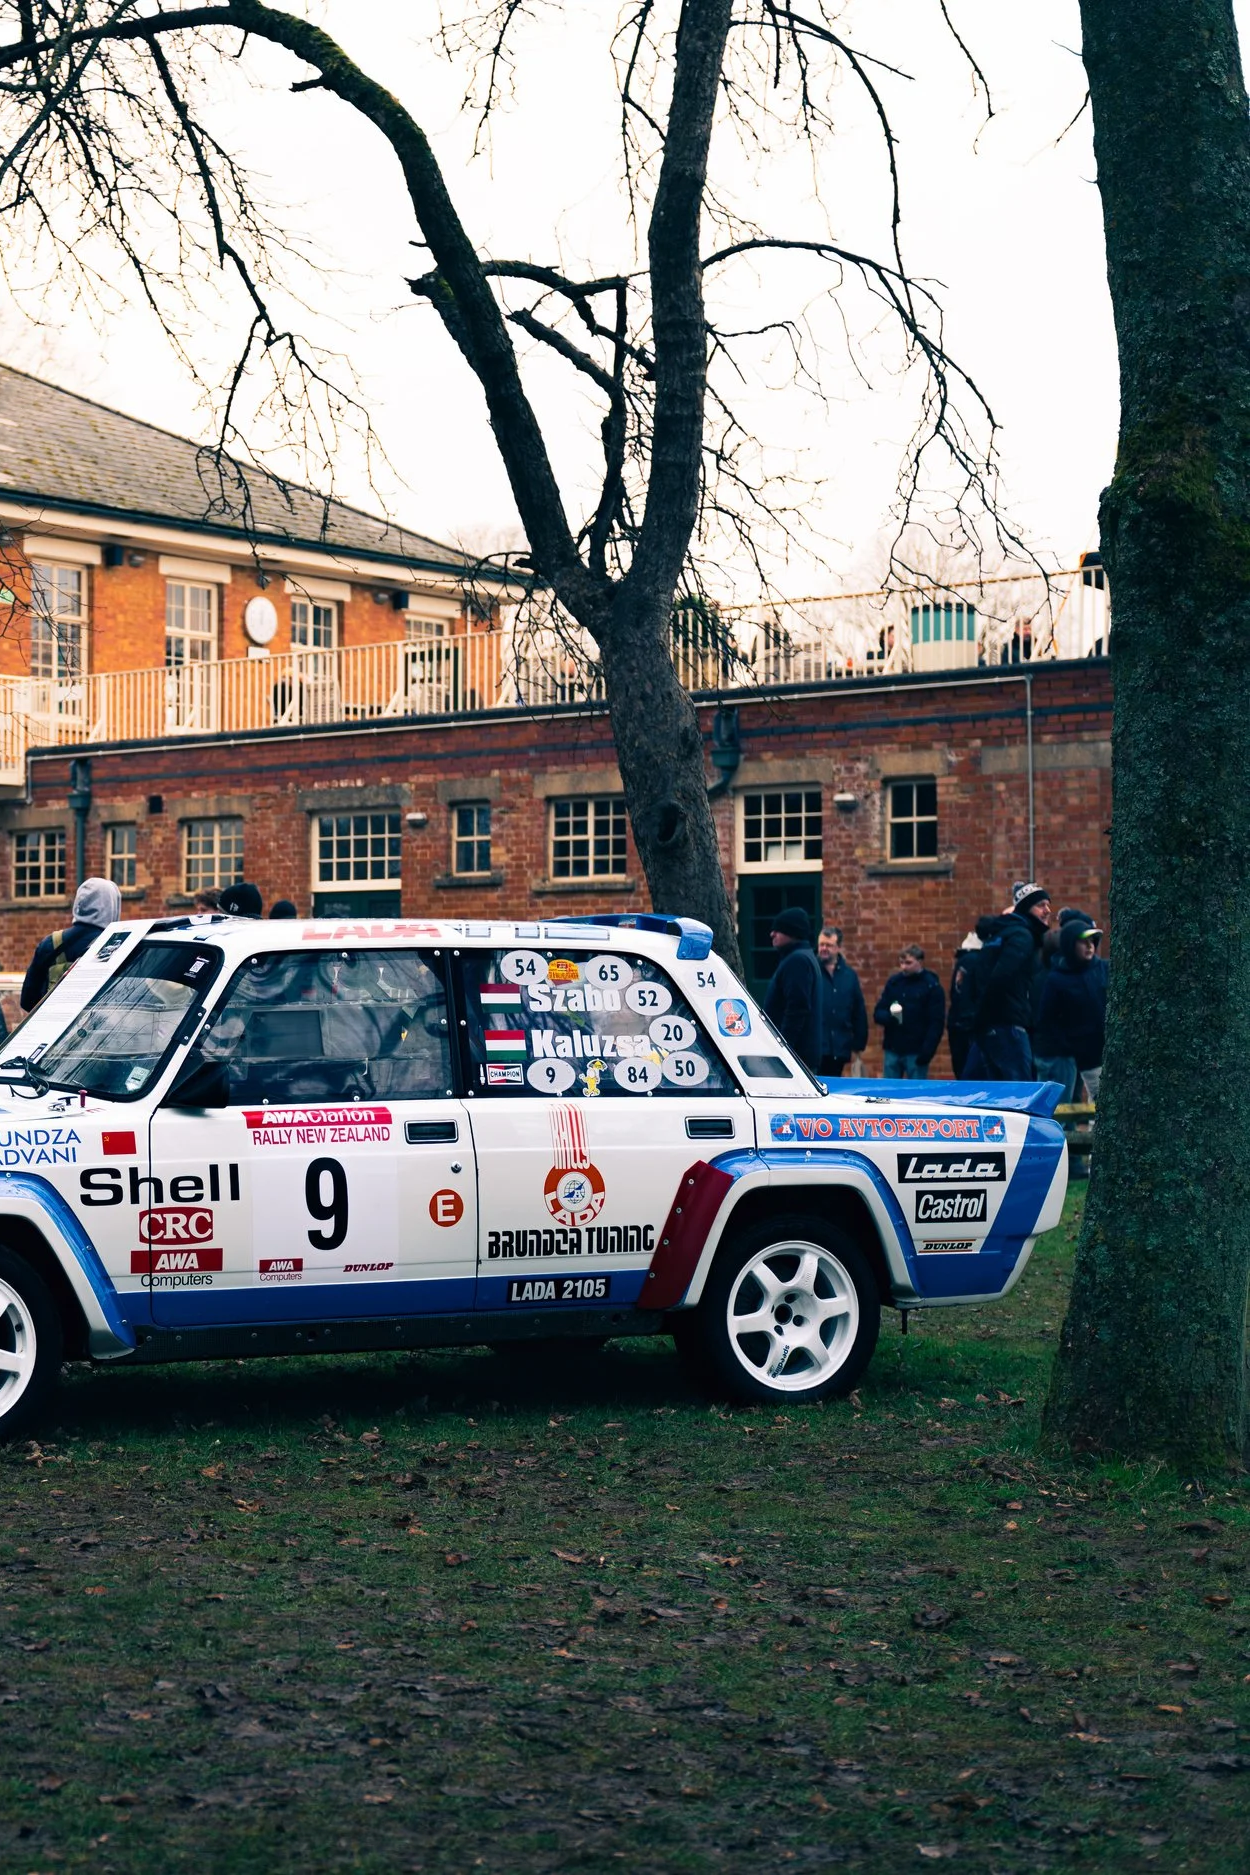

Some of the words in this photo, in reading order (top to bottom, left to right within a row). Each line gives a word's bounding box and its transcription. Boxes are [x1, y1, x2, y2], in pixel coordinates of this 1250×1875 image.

[515, 958, 536, 976] 54
[598, 964, 619, 982] 65
[697, 972, 717, 988] 54
[638, 990, 659, 1007] 52
[661, 1024, 683, 1041] 20
[531, 1029, 652, 1058] Kaluzsa
[490, 1070, 520, 1079] CHAMPION
[546, 1067, 556, 1083] 9
[628, 1067, 649, 1083] 84
[675, 1060, 696, 1077] 50
[252, 1129, 292, 1146] RALLY
[297, 1128, 326, 1144] NEW
[330, 1126, 391, 1142] ZEALAND
[796, 1117, 833, 1139] V/O
[838, 1118, 981, 1139] AVTOEXPORT
[904, 1157, 1001, 1179] Lada
[79, 1163, 241, 1207] Shell
[305, 1157, 349, 1251] 9
[436, 1194, 456, 1222] E
[544, 1191, 605, 1226] LADA
[918, 1193, 985, 1220] Castrol
[140, 1212, 212, 1240] CRC
[923, 1242, 973, 1251] DUNLOP
[154, 1252, 199, 1271] AWA
[268, 1260, 295, 1272] AWA
[343, 1262, 394, 1273] DUNLOP
[140, 1274, 213, 1289] Computers
[259, 1272, 302, 1282] Computers
[511, 1281, 556, 1301] LADA
[562, 1279, 606, 1299] 2105
